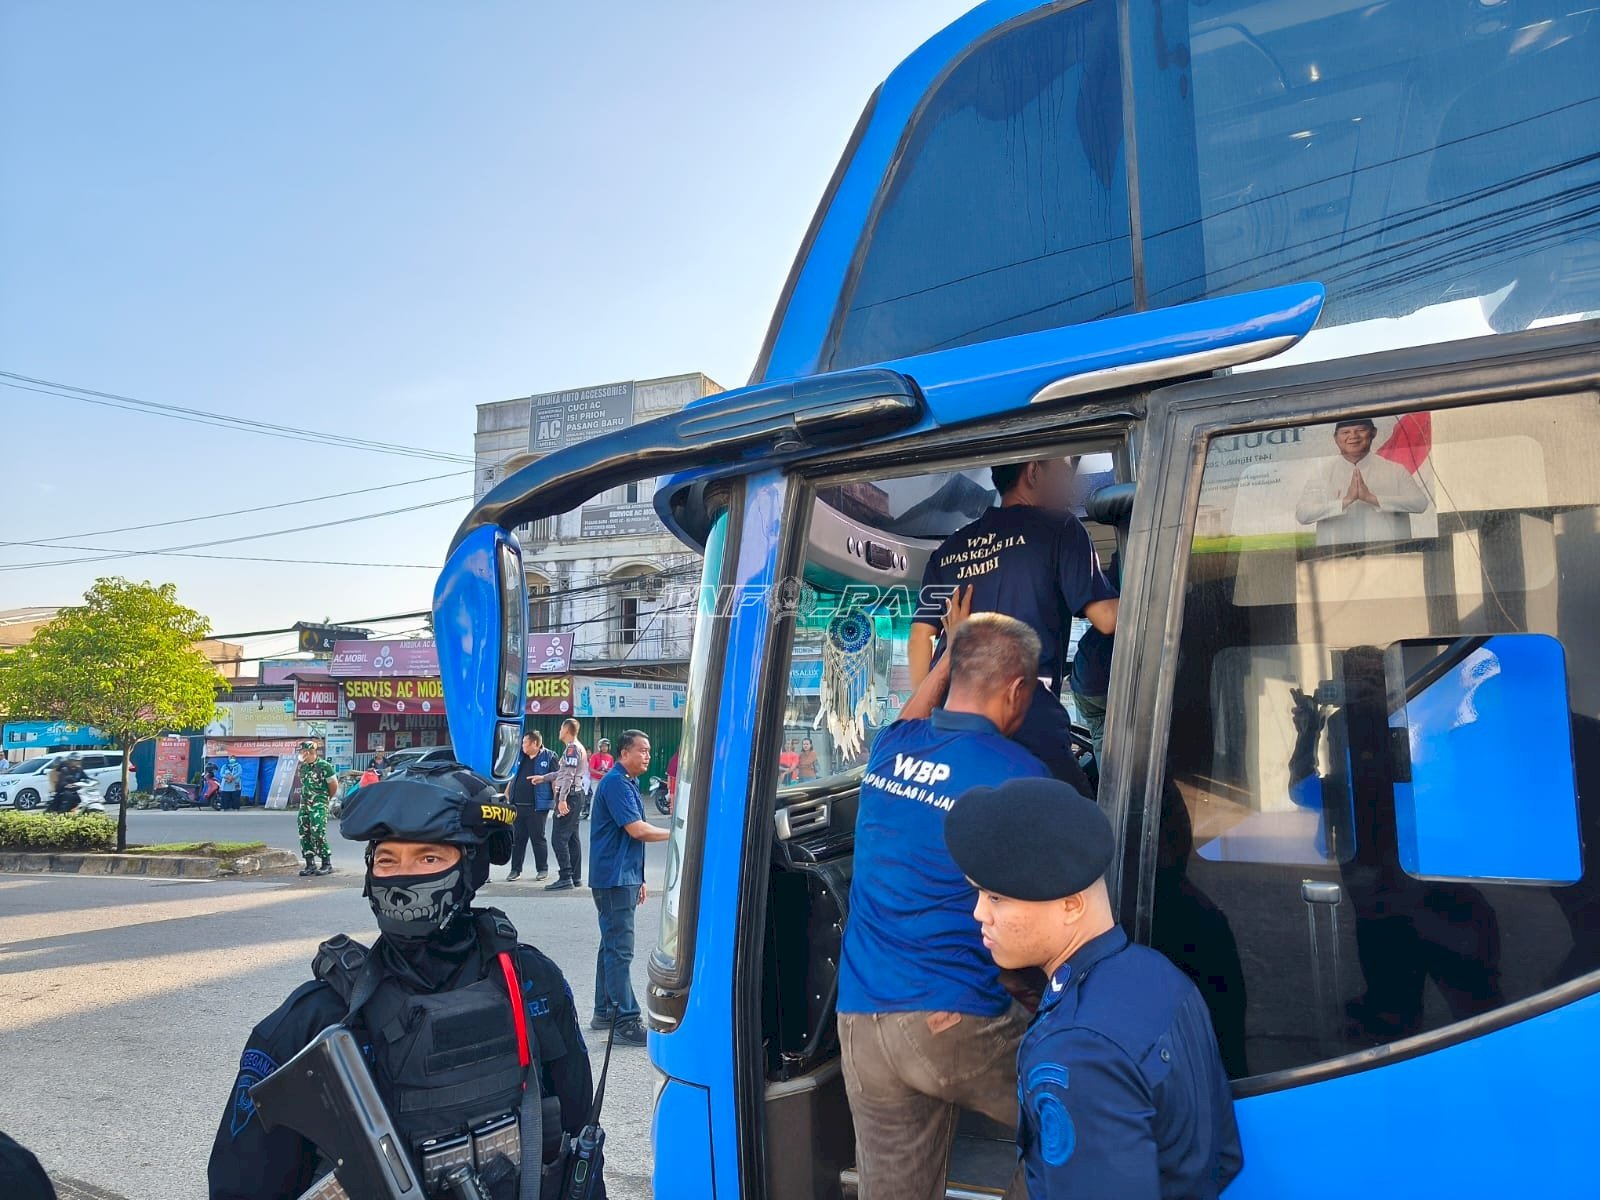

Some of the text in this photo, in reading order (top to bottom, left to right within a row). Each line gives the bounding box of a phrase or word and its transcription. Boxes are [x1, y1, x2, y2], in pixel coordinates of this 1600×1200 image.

[562, 391, 579, 402] AUTO
[567, 402, 601, 412] CUCI AC
[567, 410, 605, 421] ISI PRION
[537, 420, 561, 440] AC
[566, 418, 624, 431] PASANG BARU
[940, 535, 1026, 567] LAPAS KELAS II A
[957, 556, 1000, 579] JAMBI
[333, 654, 344, 662] AC
[344, 653, 368, 662] MOBIL
[298, 691, 337, 703] AC MOBIL
[345, 680, 393, 698] SERVIS
[396, 681, 414, 698] AC
[379, 713, 400, 730] AC
[893, 752, 951, 790] WBP
[862, 773, 887, 789] APAS
[884, 779, 919, 800] KELAS
[917, 788, 927, 802] II
[924, 791, 935, 805] A
